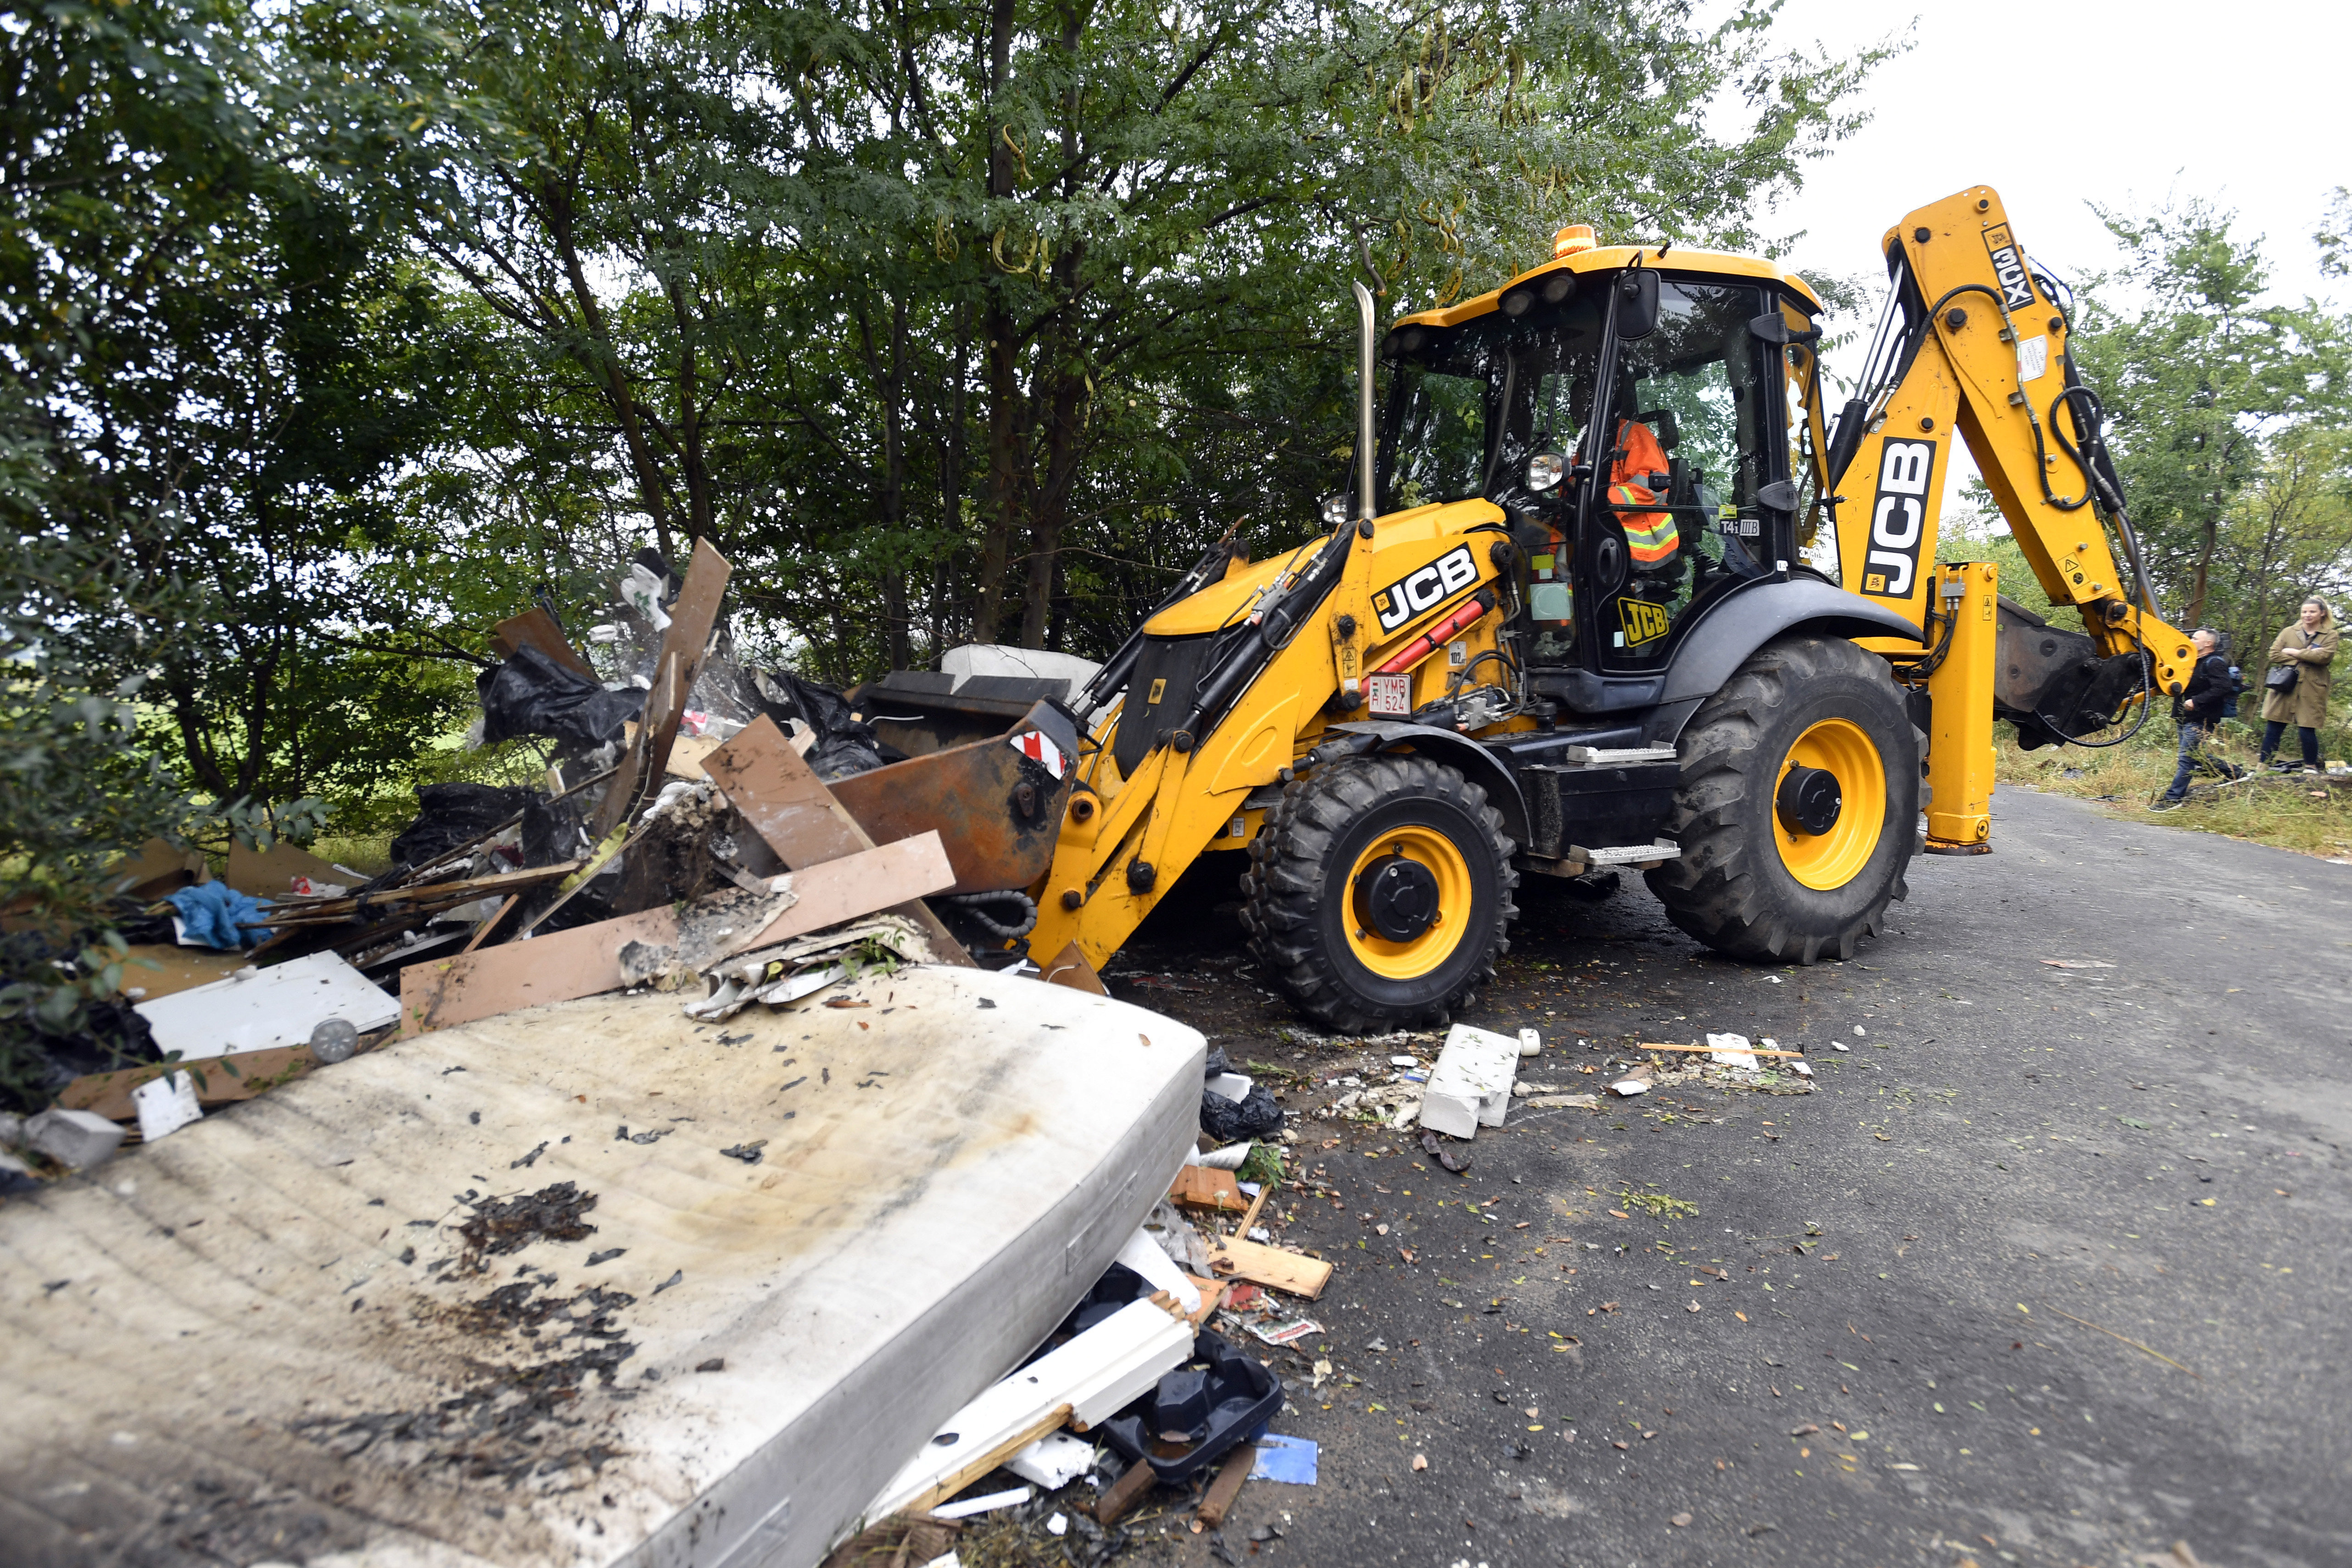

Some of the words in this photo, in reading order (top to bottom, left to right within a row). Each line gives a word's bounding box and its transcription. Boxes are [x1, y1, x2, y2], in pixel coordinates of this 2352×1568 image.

[1993, 247, 2033, 305] 3CX
[1721, 521, 1739, 534] T4i
[1741, 521, 1758, 534] IIIB
[1869, 443, 1930, 594] JCB
[1380, 548, 1476, 628] JCB
[1627, 603, 1666, 642] JCB
[1372, 694, 1379, 705] H
[1385, 679, 1406, 694] YMB
[1386, 695, 1404, 711] 524
